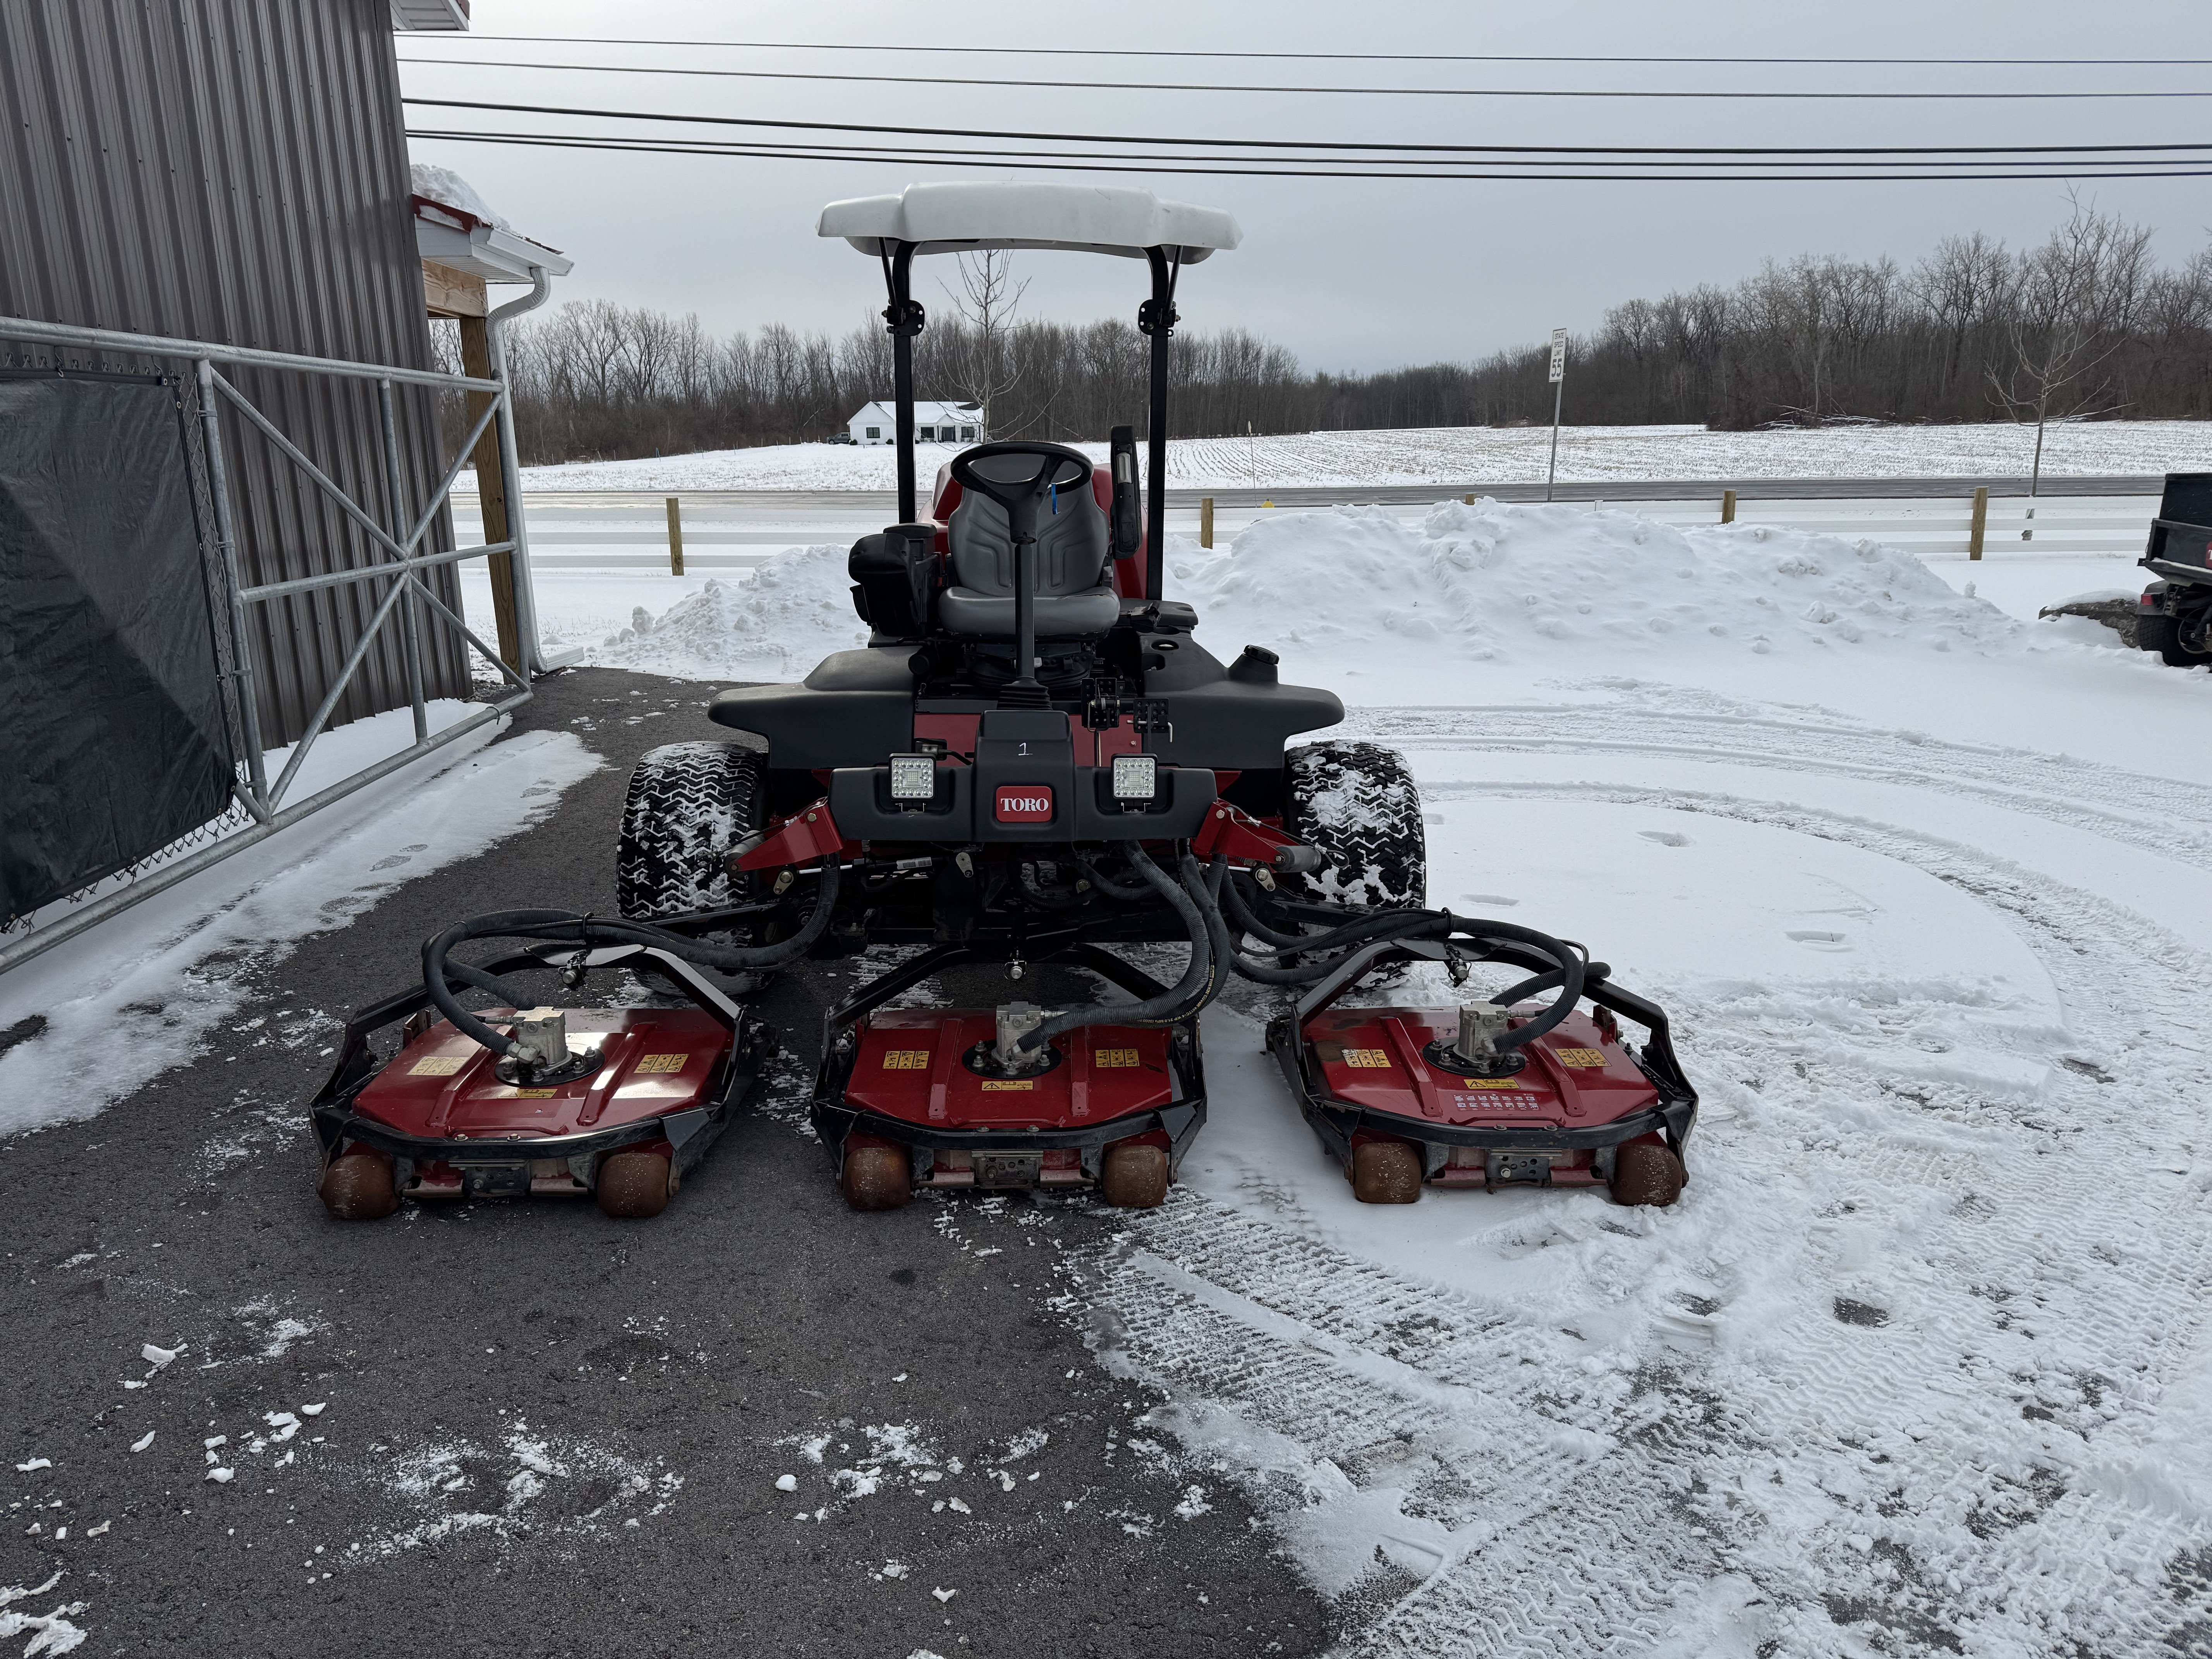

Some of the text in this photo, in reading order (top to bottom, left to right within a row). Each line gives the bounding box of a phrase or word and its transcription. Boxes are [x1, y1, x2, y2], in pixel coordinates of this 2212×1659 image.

[1551, 358, 1562, 377] 55
[1018, 742, 1033, 756] 1
[1000, 798, 1049, 811] TORO
